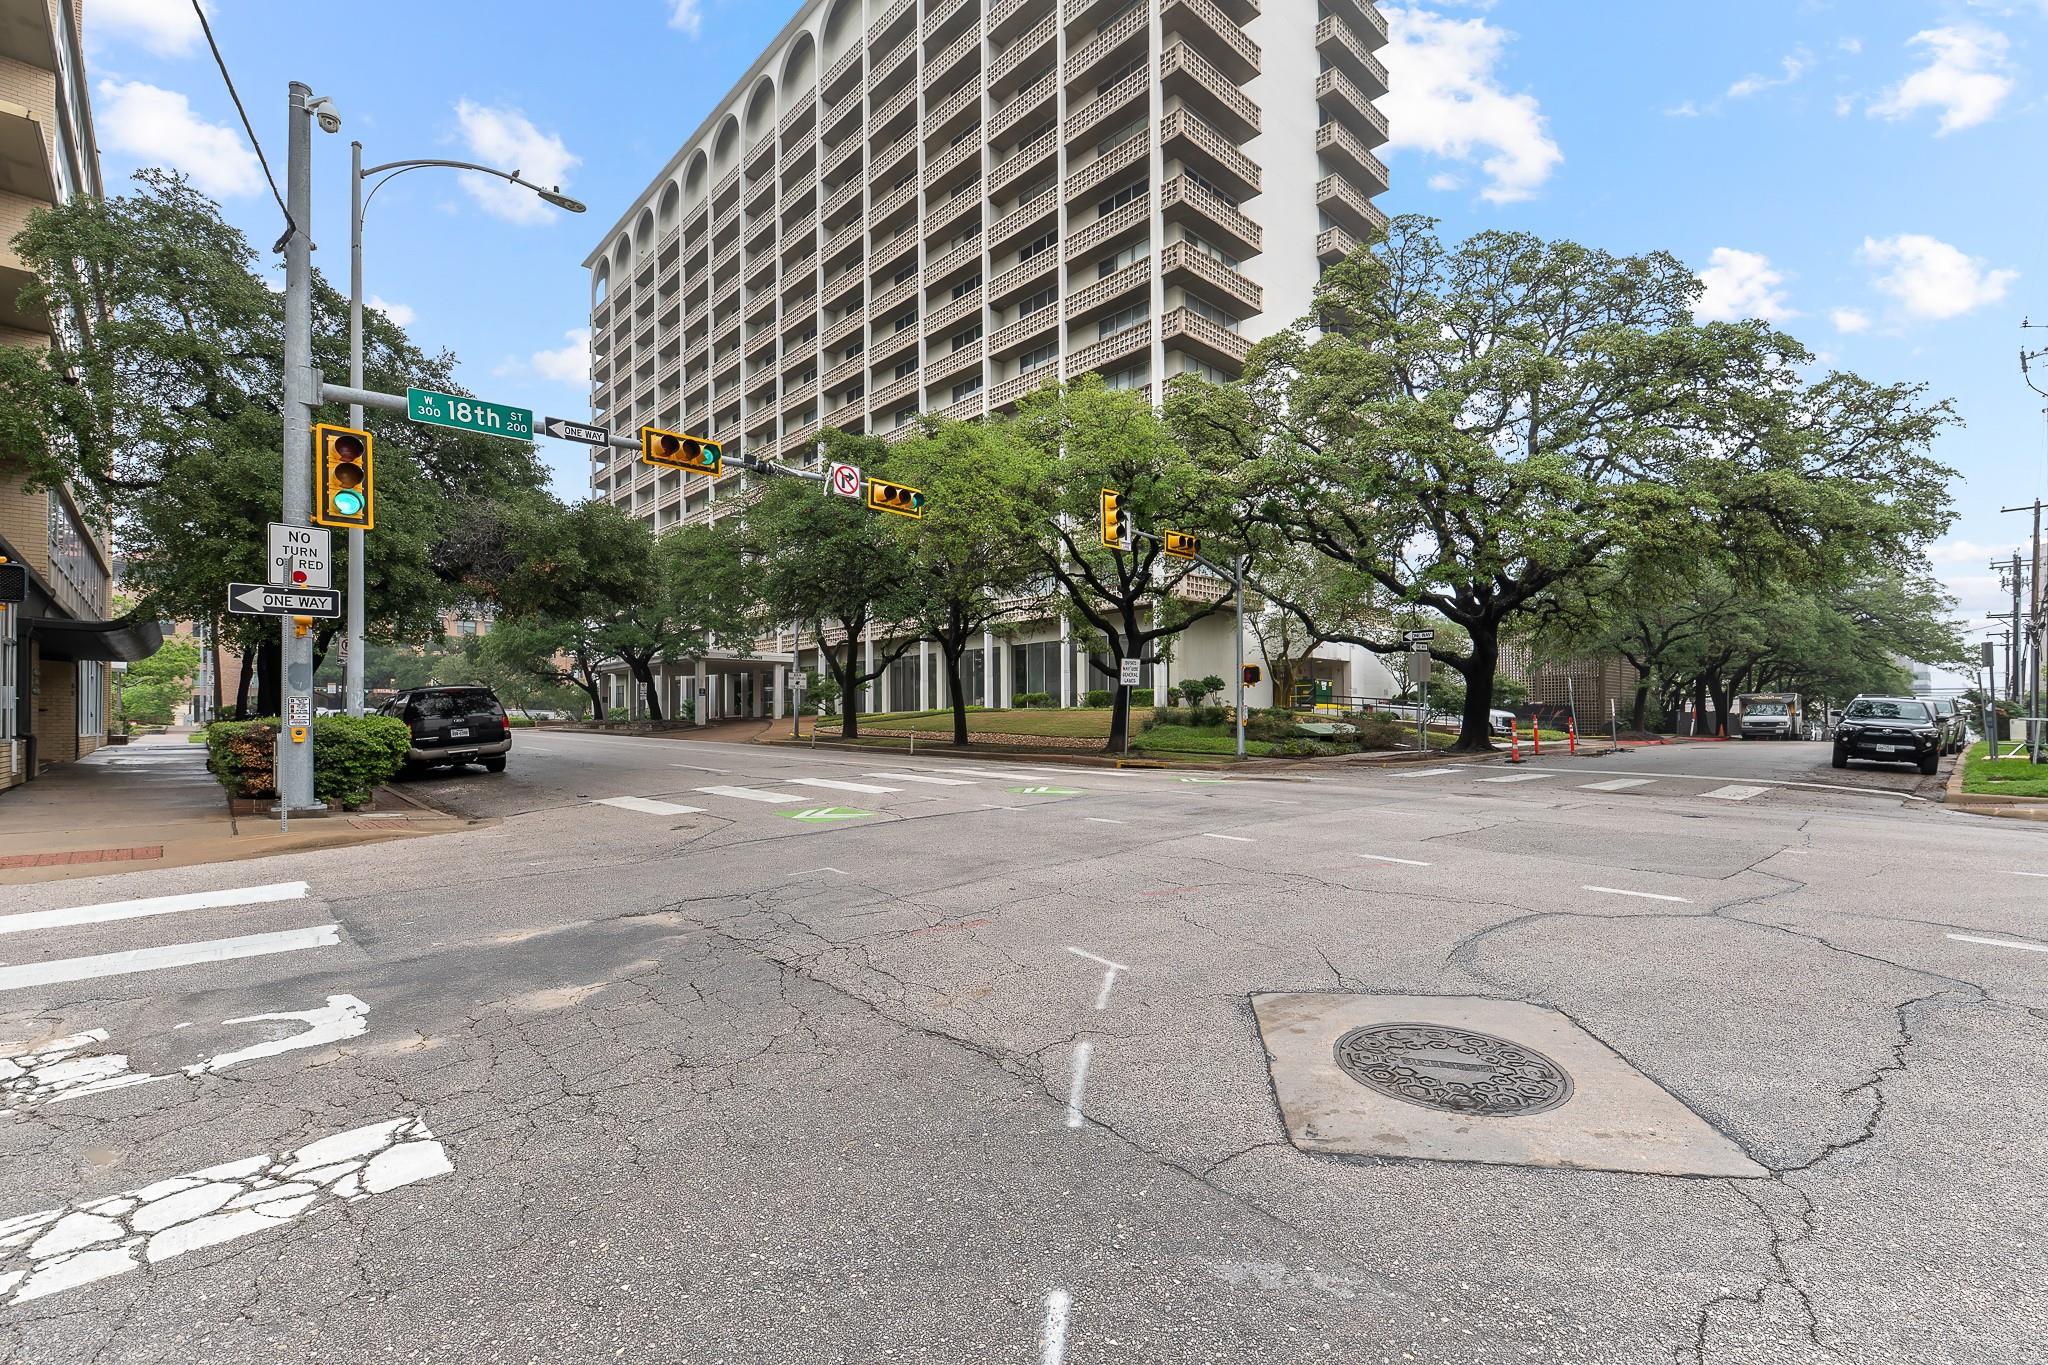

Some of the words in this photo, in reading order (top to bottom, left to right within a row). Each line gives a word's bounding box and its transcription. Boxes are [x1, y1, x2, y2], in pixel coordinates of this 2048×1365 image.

[423, 395, 433, 406] W
[417, 405, 441, 418] 300
[447, 400, 500, 429] 18th
[510, 411, 523, 422] ST
[506, 421, 528, 433] 200
[564, 426, 583, 438] ONE
[584, 429, 603, 442] WAY
[288, 530, 311, 544] NO
[282, 545, 317, 557] TURN
[299, 560, 324, 570] RED
[263, 594, 293, 607] ONE
[298, 596, 328, 609] WAY
